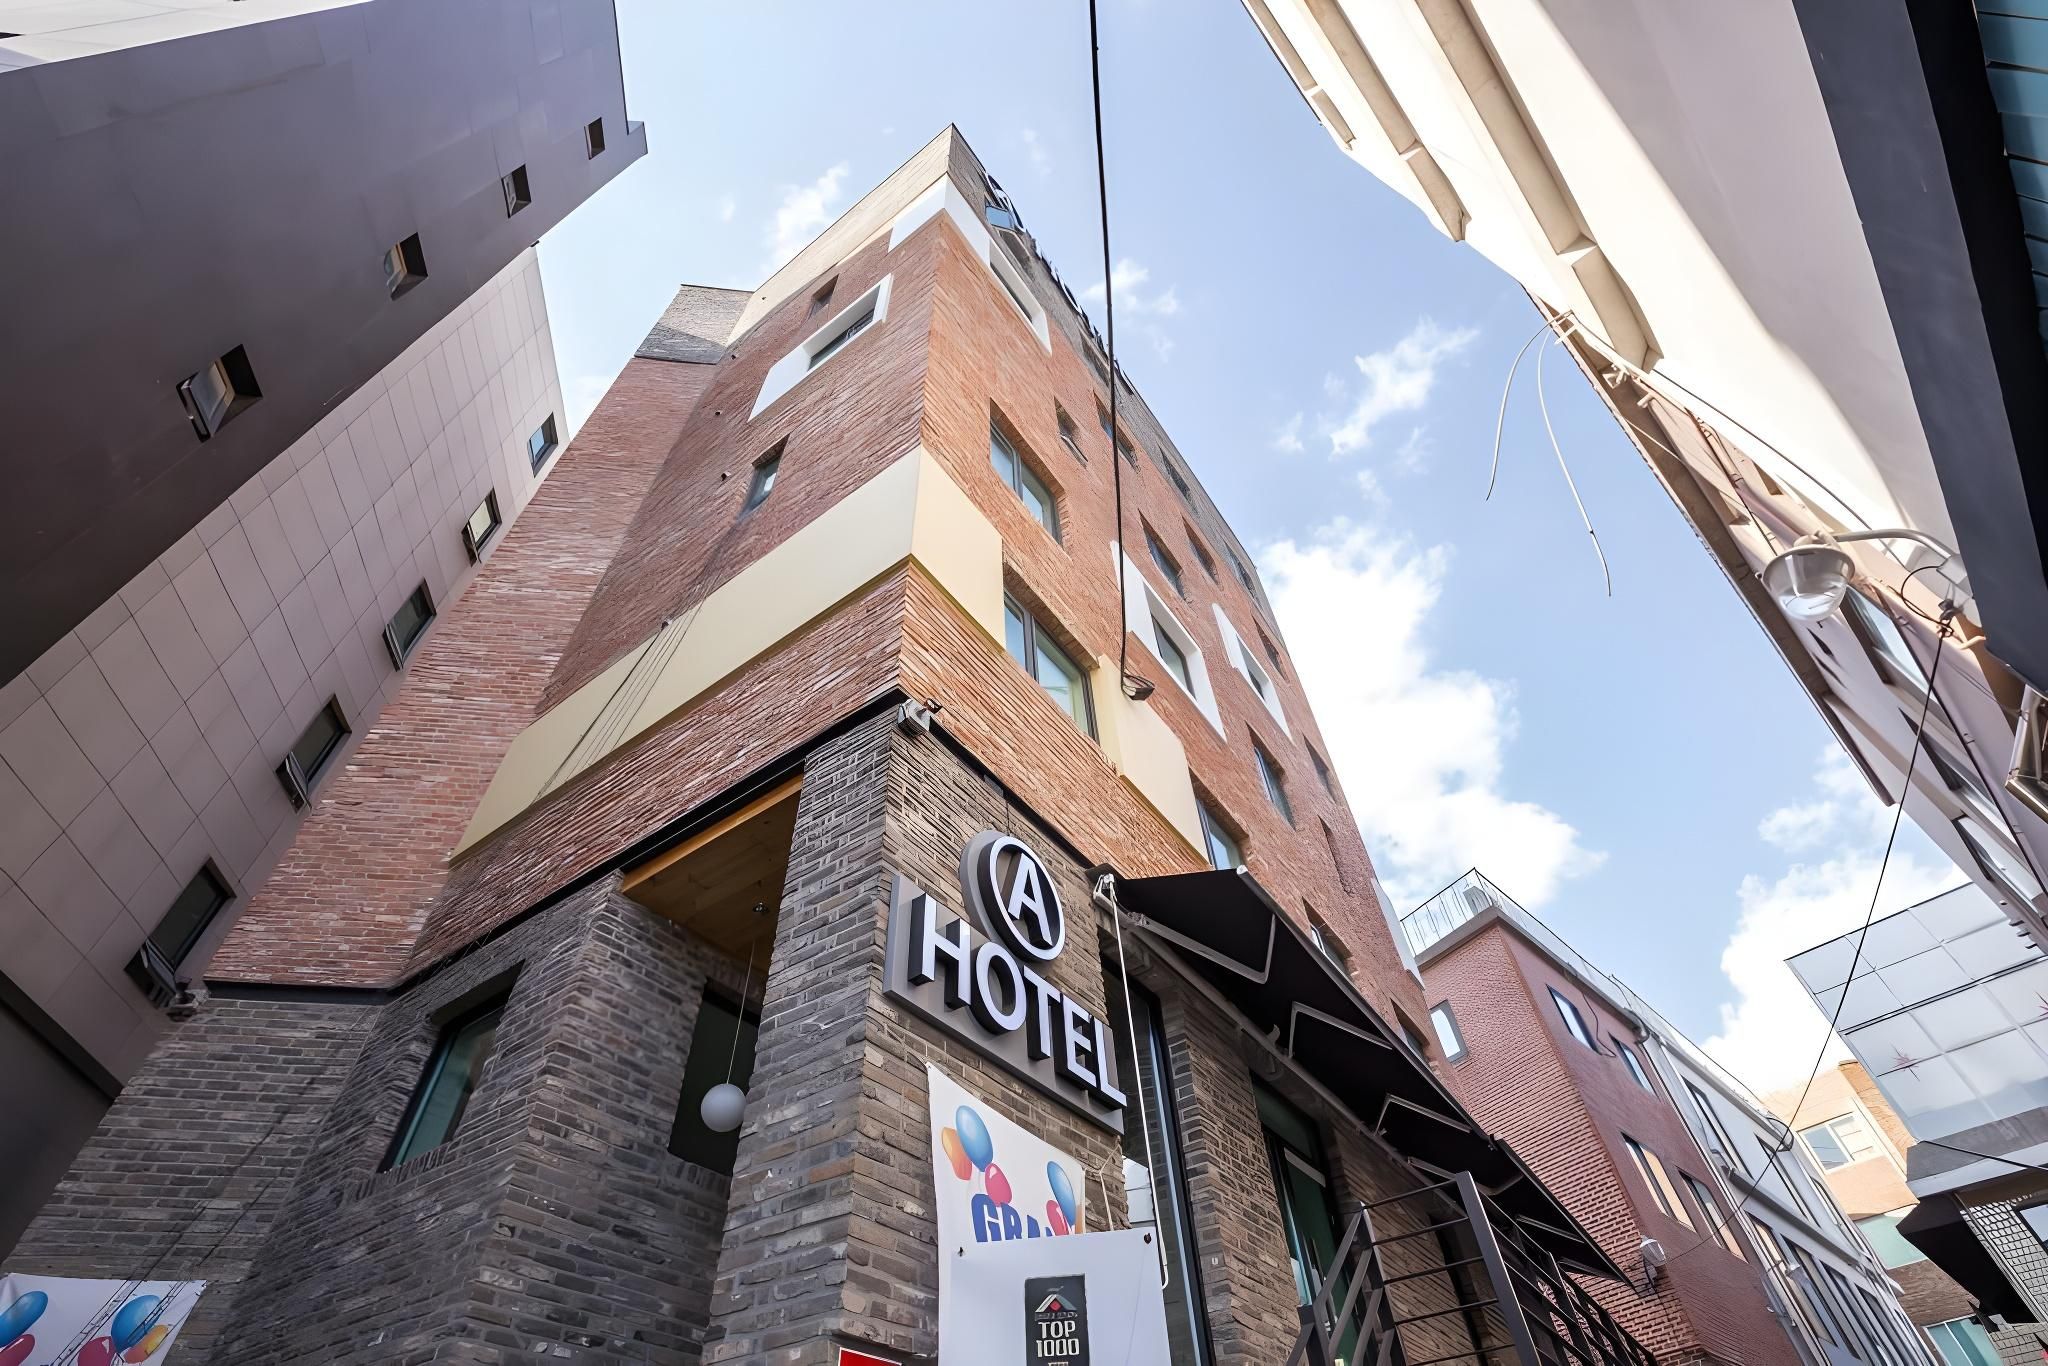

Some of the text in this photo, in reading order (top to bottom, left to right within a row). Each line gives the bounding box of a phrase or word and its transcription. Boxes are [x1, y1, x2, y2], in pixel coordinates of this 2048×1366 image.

[1000, 850, 1054, 947] A
[909, 892, 1128, 1107] HOTEL
[1035, 1338, 1080, 1358] 1000
[1037, 1320, 1077, 1339] TOP
